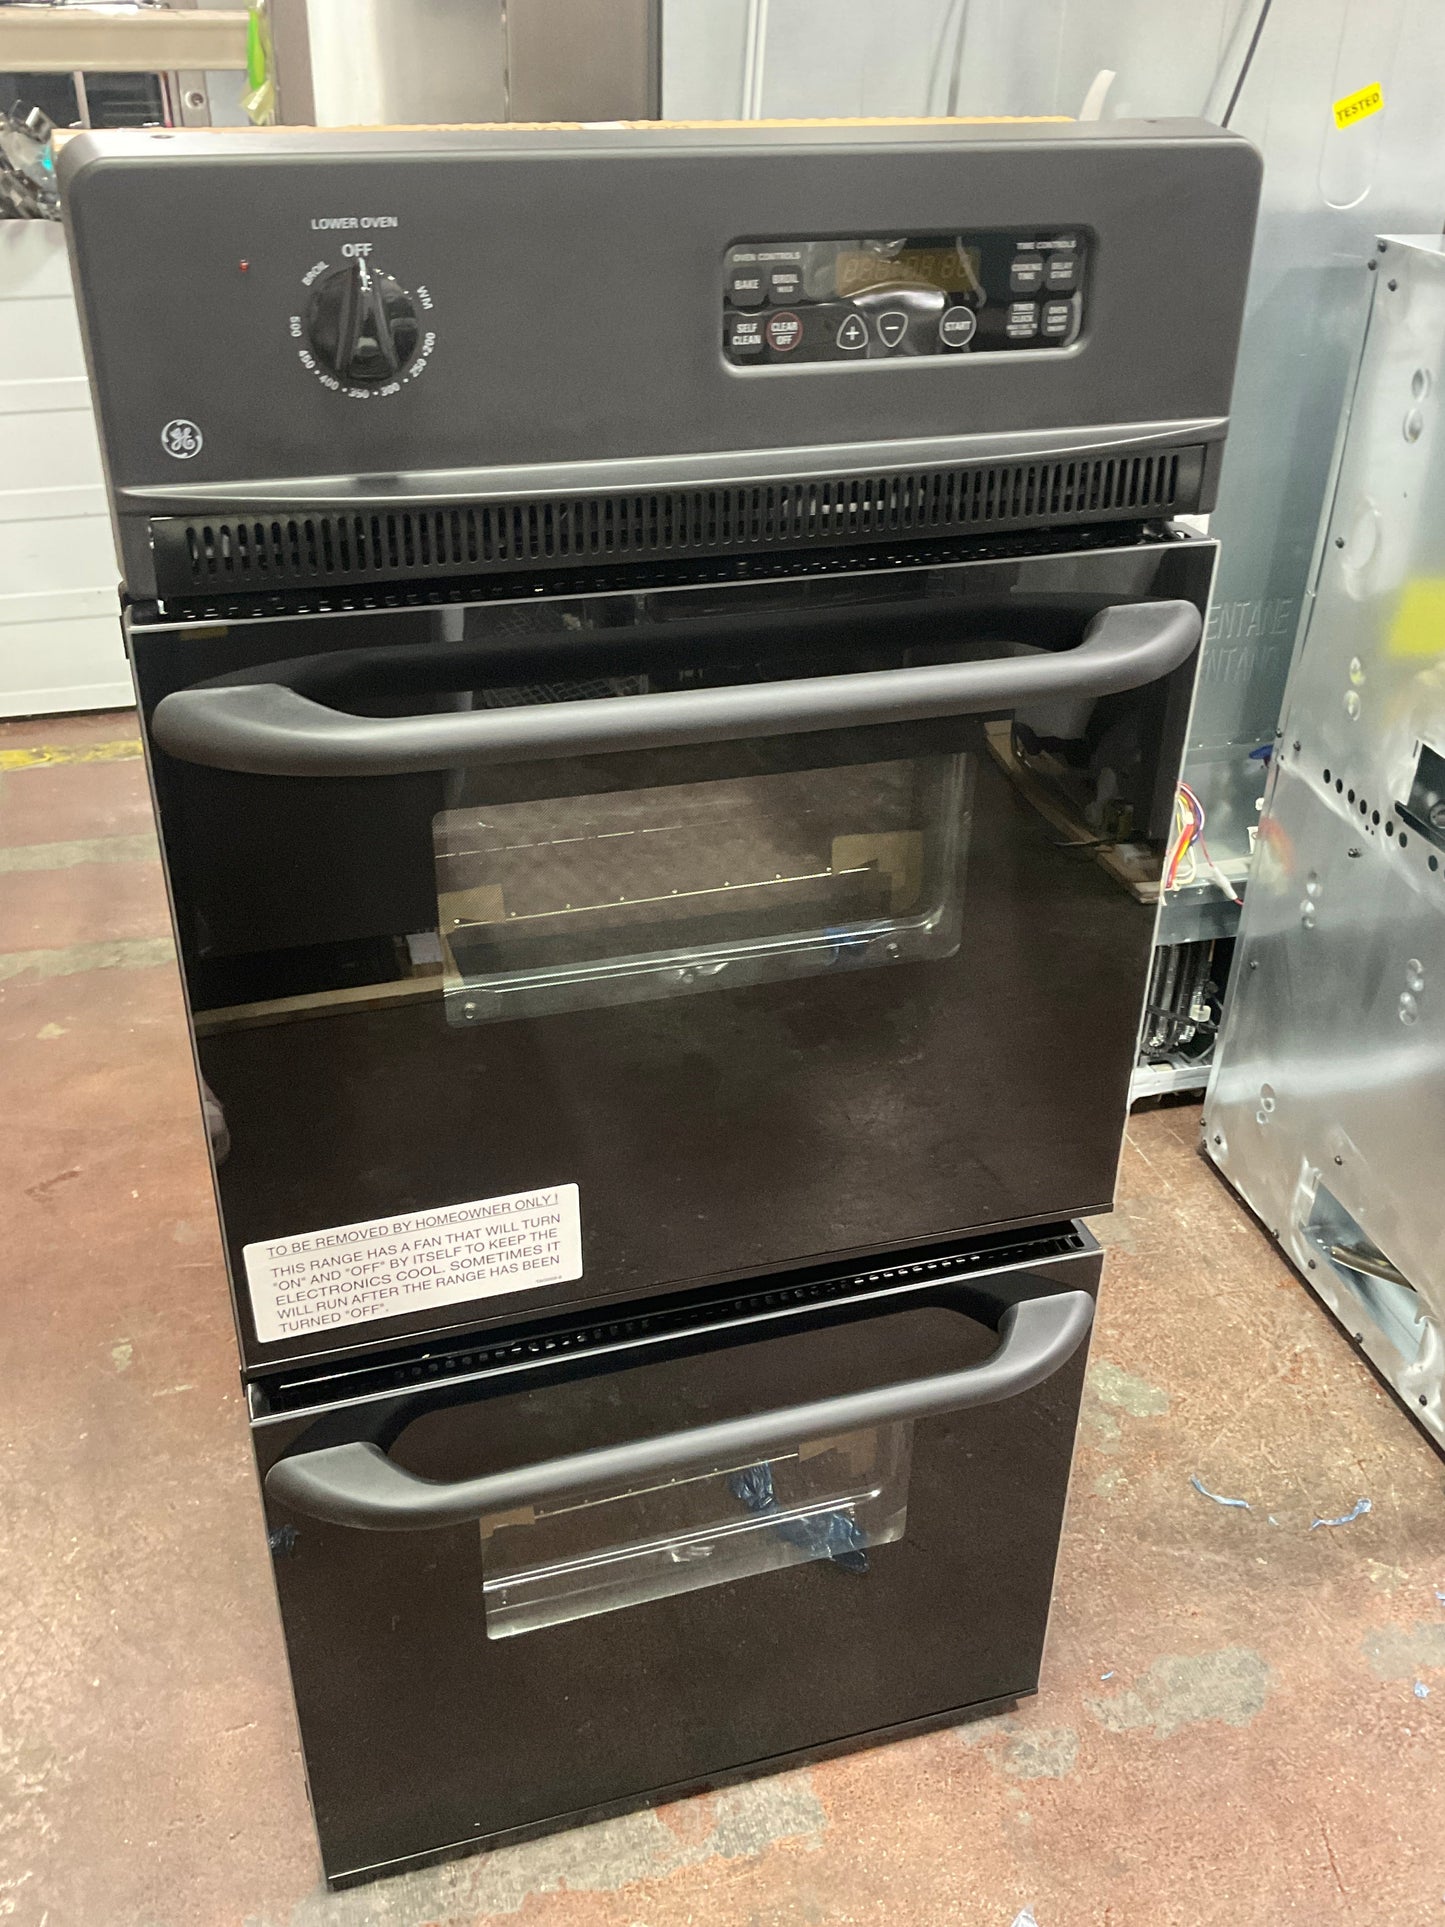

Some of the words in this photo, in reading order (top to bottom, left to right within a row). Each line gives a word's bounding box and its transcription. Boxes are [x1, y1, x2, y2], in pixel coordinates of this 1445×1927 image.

[1336, 92, 1380, 122] TESTED
[311, 217, 359, 230] LOWER
[360, 216, 398, 229] OVEN
[341, 243, 373, 257] OFF
[734, 279, 760, 290] BAKE
[416, 285, 433, 310] WM
[290, 316, 302, 337] 500
[736, 322, 758, 333] SELF
[770, 321, 798, 332] CLEAR
[944, 321, 971, 332] START
[422, 332, 436, 353] 200
[732, 334, 762, 345] CLEAN
[776, 335, 793, 346] OFF
[299, 350, 316, 369] 450
[408, 358, 427, 377] 250
[319, 375, 339, 391] 400
[380, 382, 400, 397] 300
[348, 387, 370, 399] 350
[267, 1245, 287, 1258] TO
[292, 1240, 312, 1253] BE
[316, 1225, 388, 1248] REMOVED
[393, 1220, 412, 1233] BY
[415, 1202, 512, 1229] HOMEOWNER
[271, 1263, 306, 1278] THIS
[310, 1251, 363, 1271] RANGE
[367, 1245, 397, 1260] HAS
[401, 1242, 411, 1253] A
[414, 1236, 442, 1250] FAN
[445, 1228, 482, 1244] THAT
[485, 1222, 519, 1236] WILL
[521, 1213, 561, 1230] TURN
[273, 1277, 306, 1291] "ON"
[310, 1270, 341, 1284] AND
[345, 1261, 385, 1276] "OFF"
[390, 1256, 409, 1269] BY
[413, 1247, 462, 1264] ITSELF
[465, 1242, 485, 1254] TO
[489, 1234, 526, 1250] KEEP
[529, 1228, 558, 1242] THE
[276, 1274, 391, 1306] ELECTRONICS
[396, 1264, 446, 1281] COOL.
[450, 1244, 543, 1271] SOMETIMES
[547, 1241, 561, 1252] IT
[277, 1305, 313, 1319] WILL
[316, 1298, 348, 1312] RUN
[351, 1286, 399, 1305] AFTER
[403, 1279, 432, 1294] THE
[436, 1269, 486, 1288] RANGE
[490, 1262, 519, 1277] HAS
[522, 1255, 560, 1271] BEEN
[279, 1312, 341, 1333] TURNED
